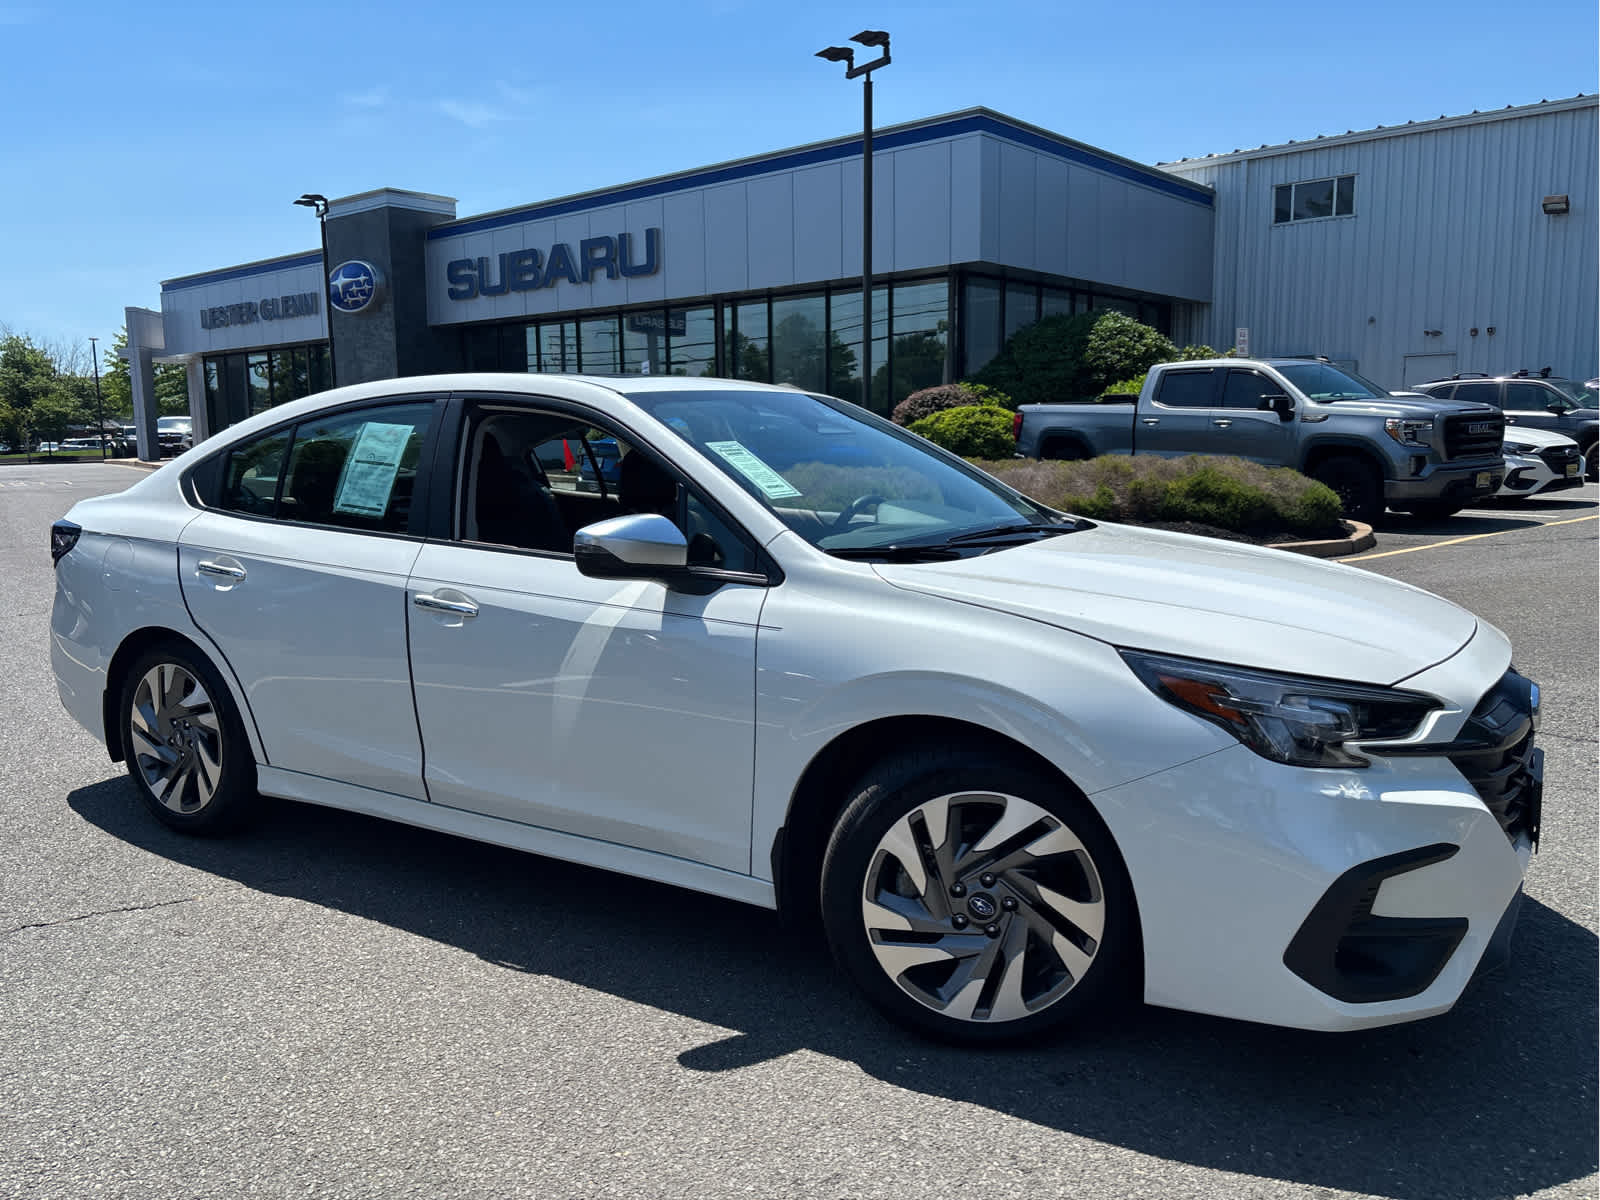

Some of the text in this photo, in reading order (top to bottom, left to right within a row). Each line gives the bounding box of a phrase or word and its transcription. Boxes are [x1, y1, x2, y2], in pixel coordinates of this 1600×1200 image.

[447, 228, 660, 300] SUBARU
[200, 292, 319, 330] LESTER GLENN
